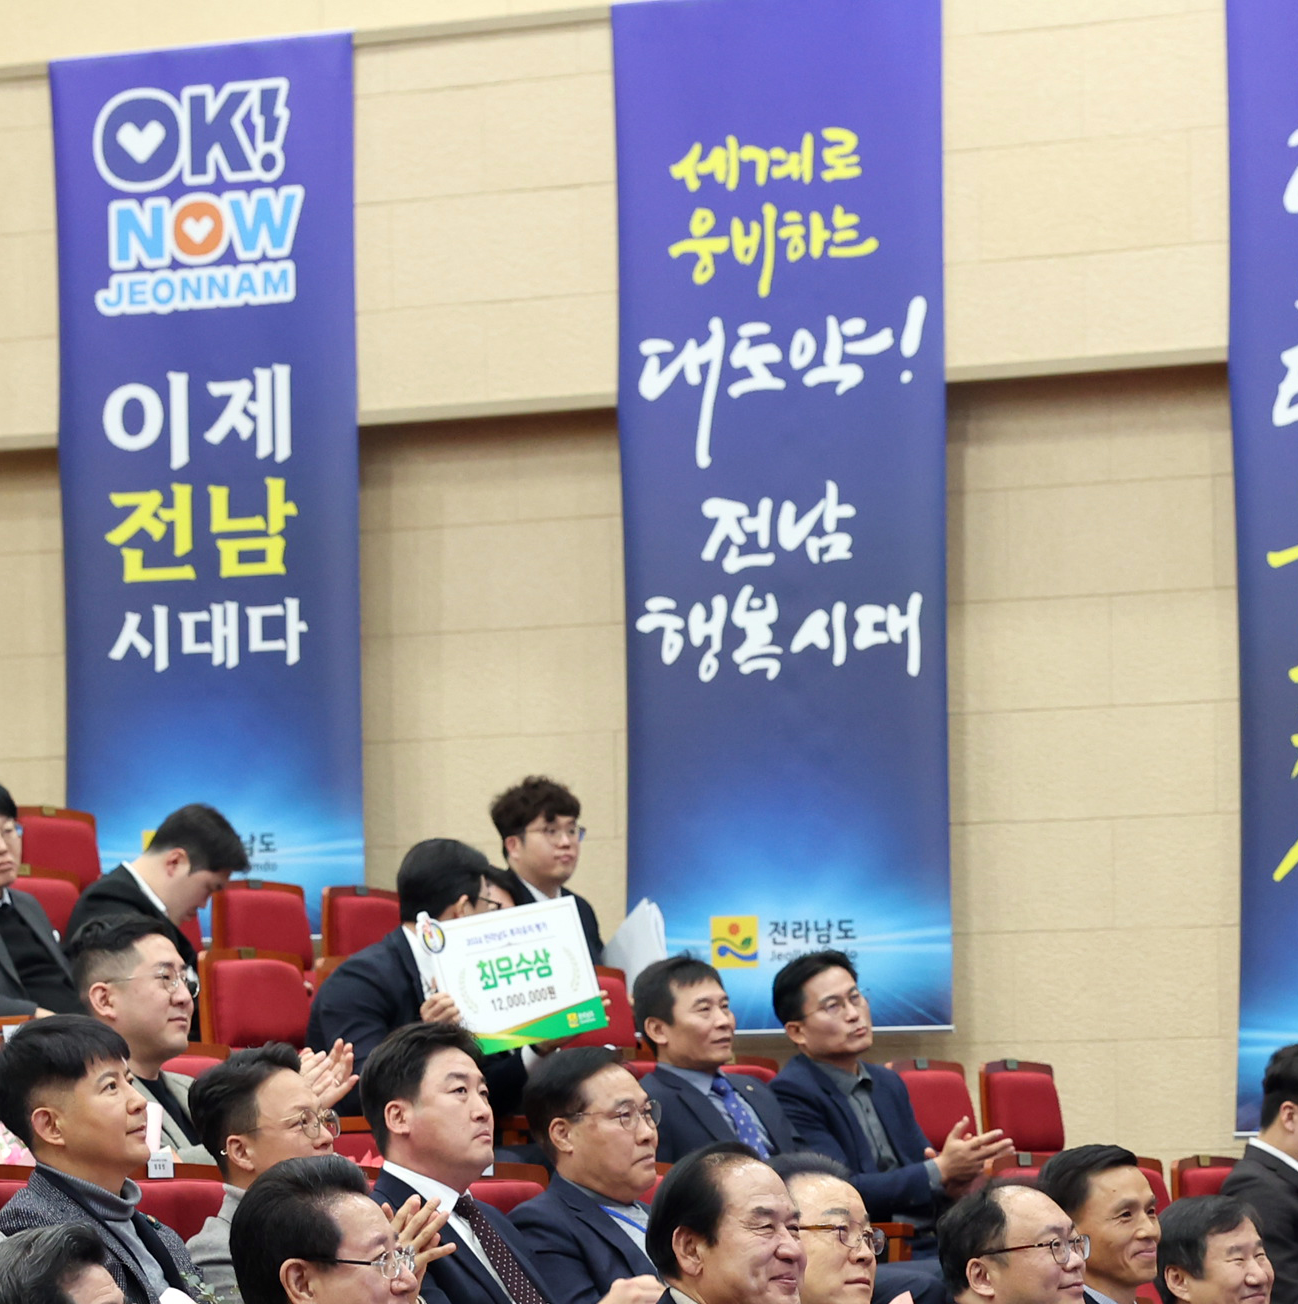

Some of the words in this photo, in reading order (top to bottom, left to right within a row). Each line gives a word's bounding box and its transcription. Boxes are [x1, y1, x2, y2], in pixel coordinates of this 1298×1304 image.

[669, 127, 863, 192] 세계로
[108, 186, 304, 270] NOW
[668, 202, 880, 298] 웅비하는
[95, 262, 297, 315] JEONNAM
[102, 363, 293, 470] 이제
[638, 296, 928, 469] 대도약!
[104, 477, 299, 584] 전남
[701, 480, 857, 574] 전남
[108, 597, 308, 672] 시대다
[768, 918, 857, 946] 전라남도
